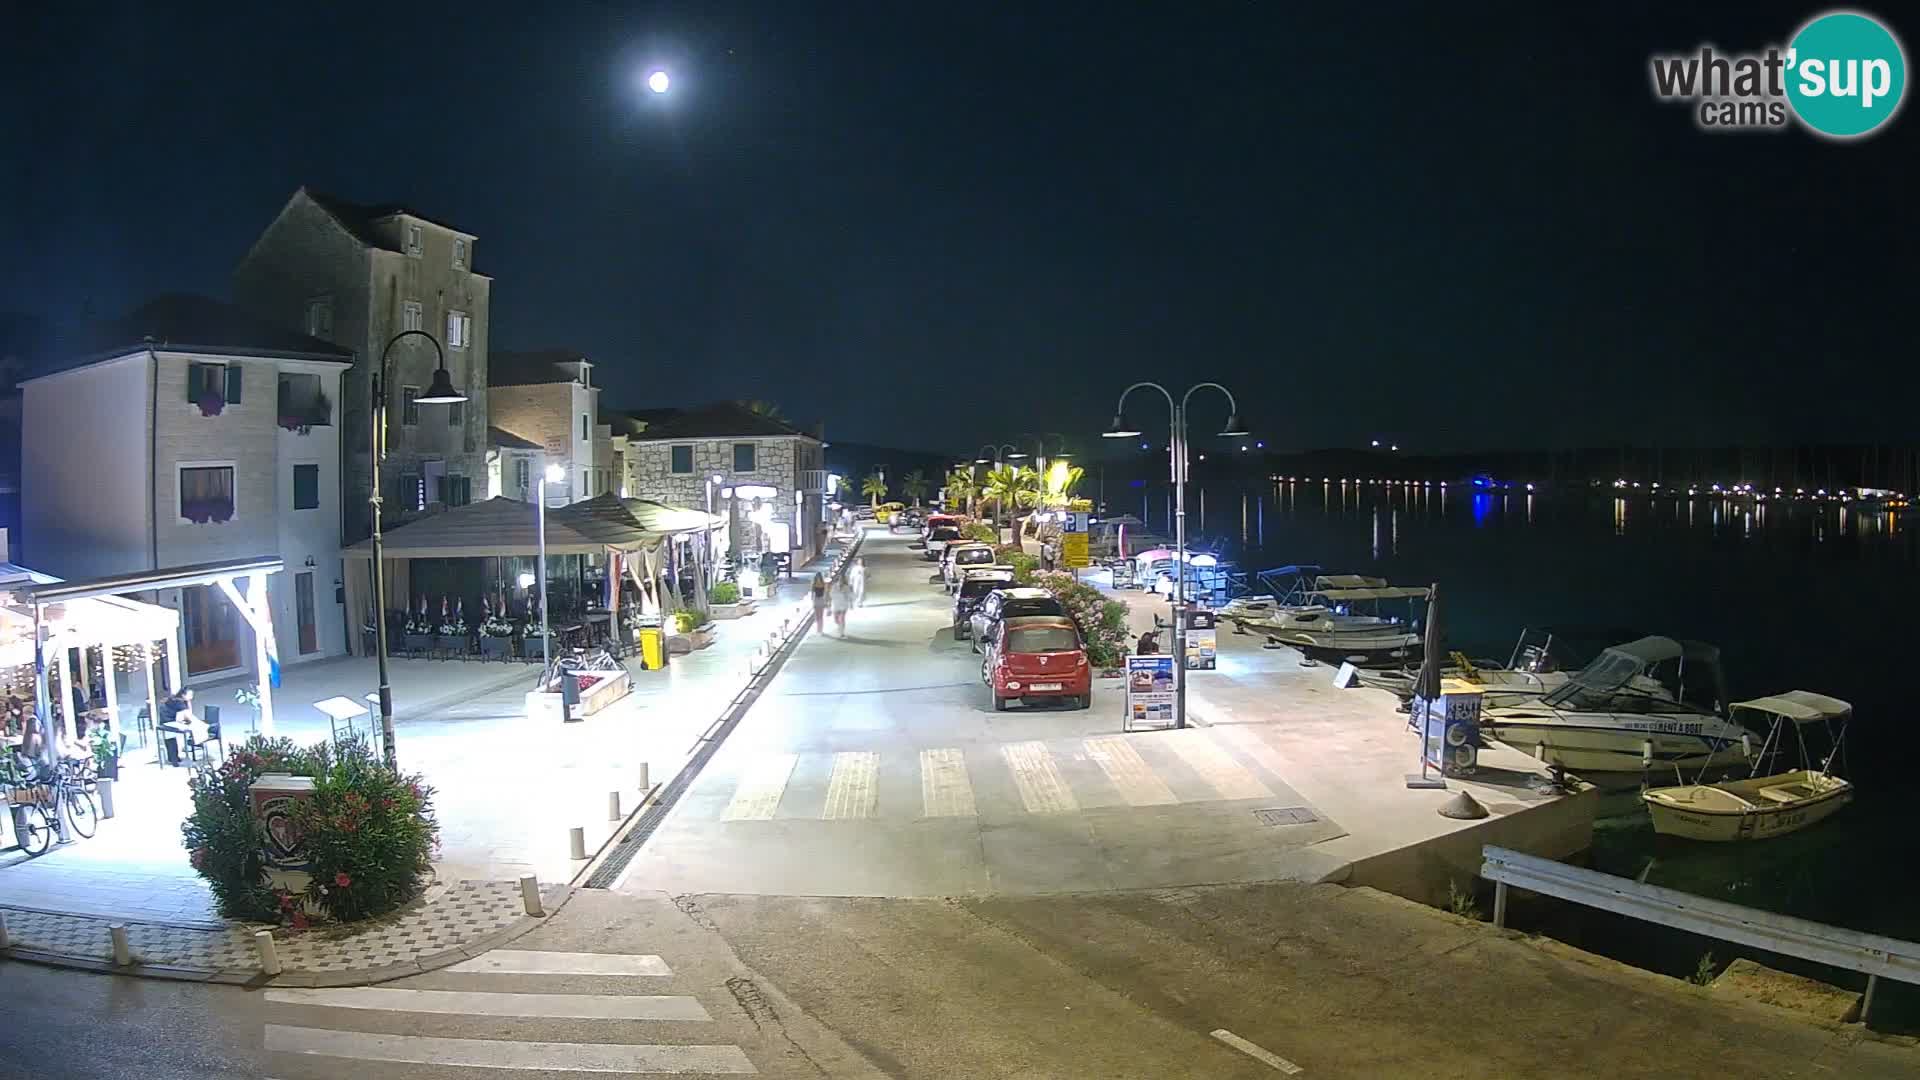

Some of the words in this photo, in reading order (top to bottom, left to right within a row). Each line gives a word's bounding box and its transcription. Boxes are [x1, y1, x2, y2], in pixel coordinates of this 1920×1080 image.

[1065, 514, 1075, 531] P
[1448, 699, 1480, 710] RENT
[1447, 712, 1453, 720] A
[1455, 711, 1479, 720] BOAT
[1659, 722, 1677, 733] RENT
[1686, 724, 1704, 735] BOAT
